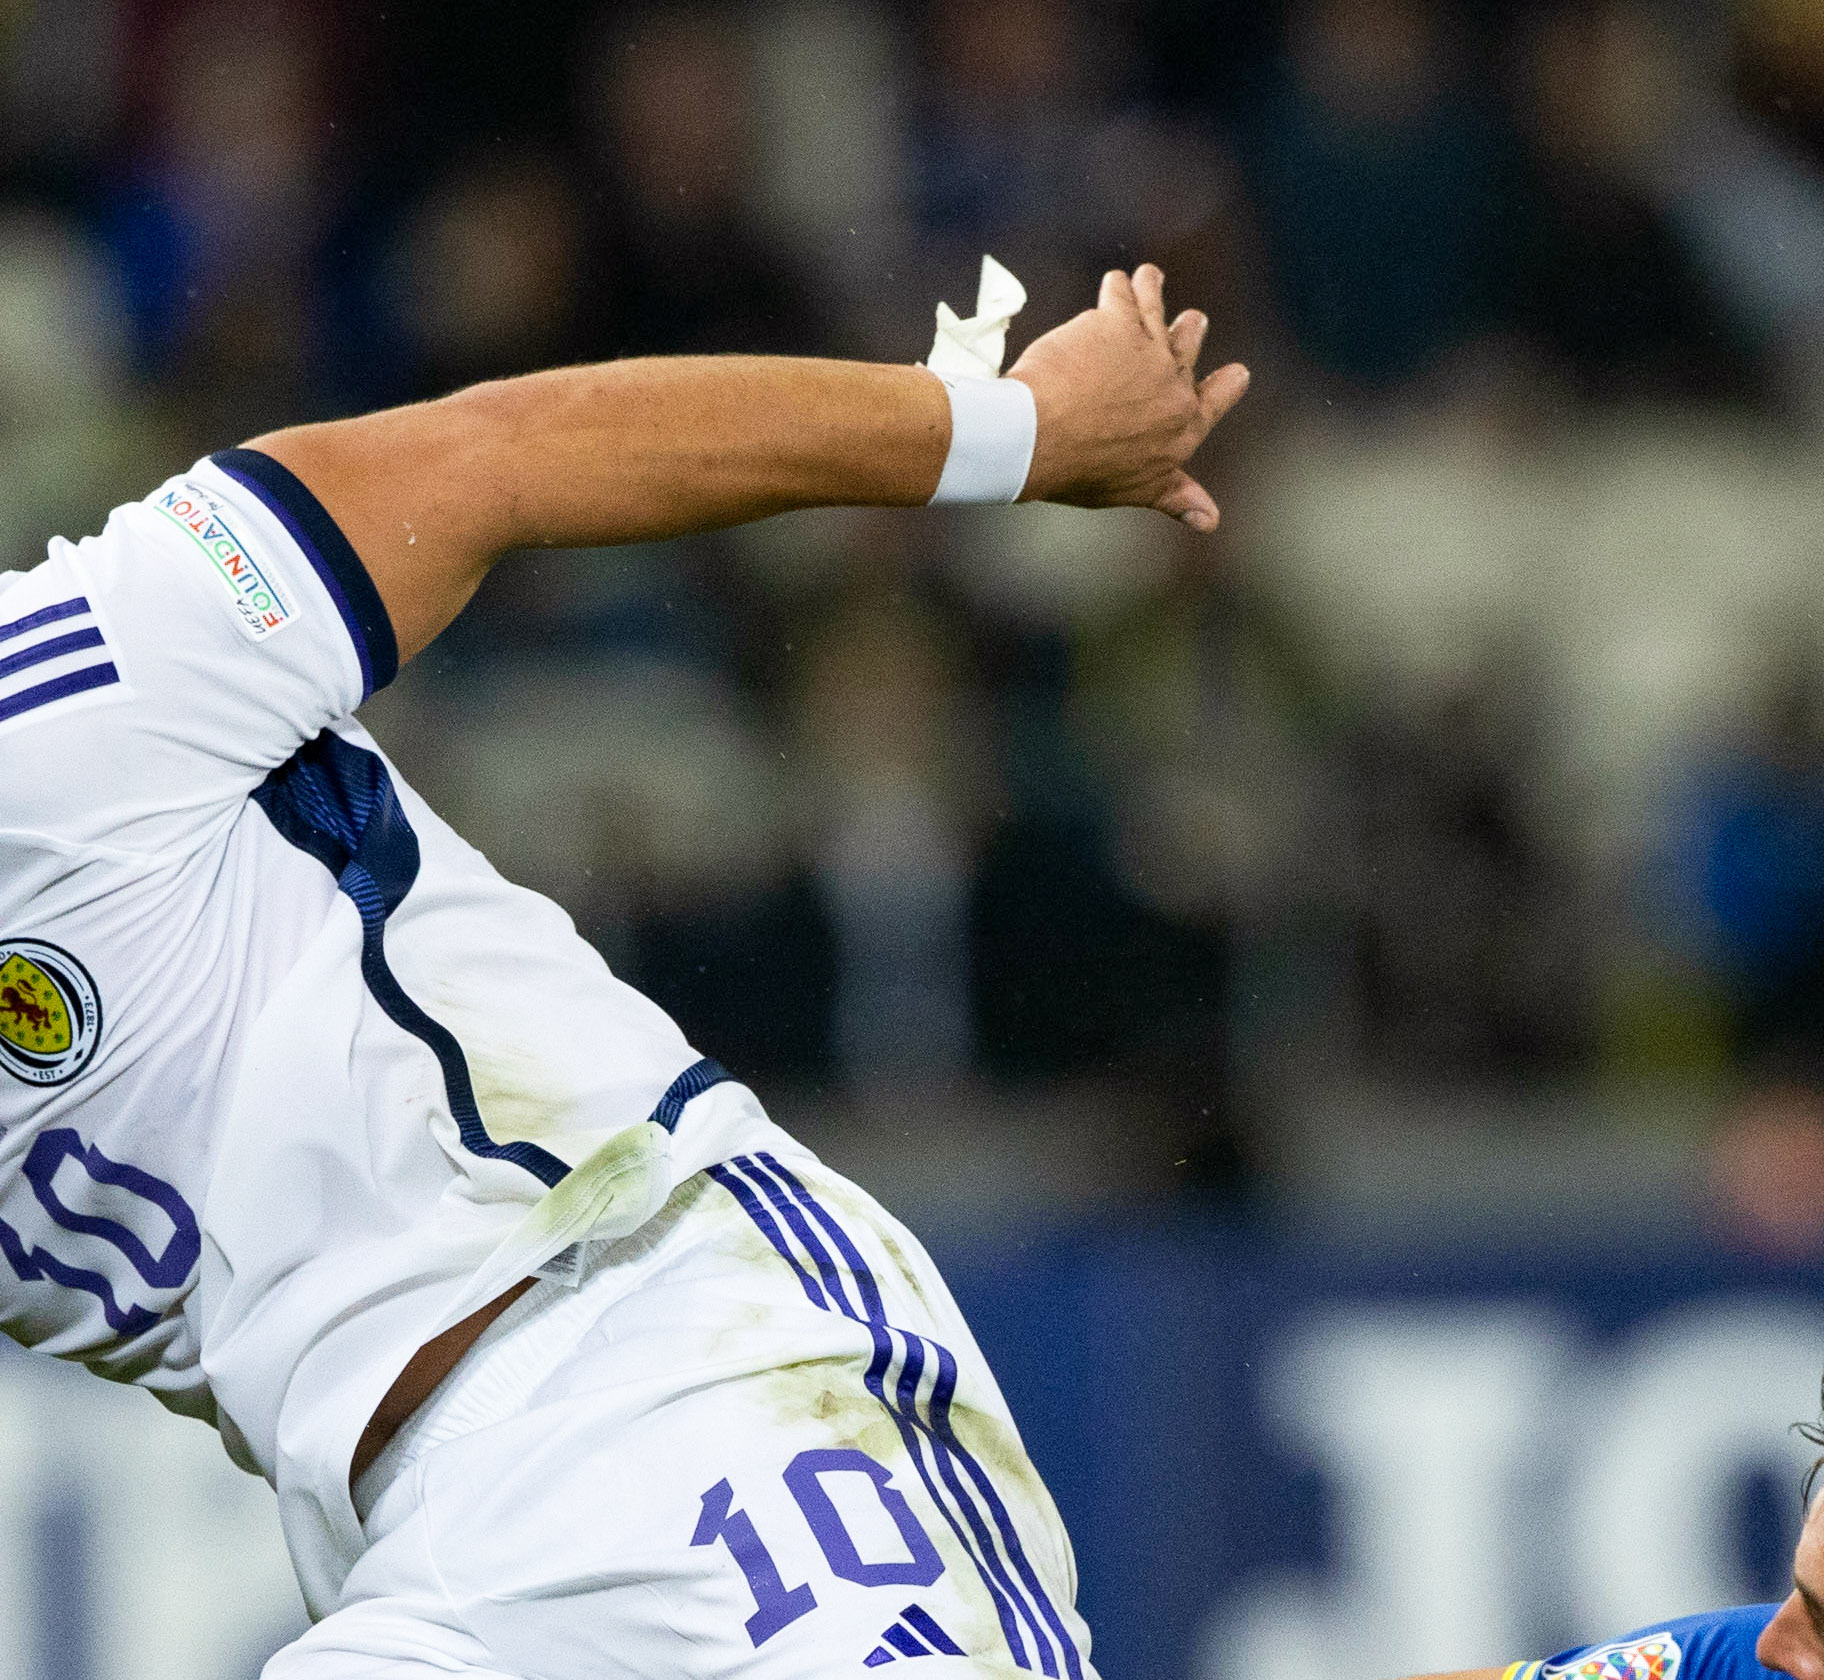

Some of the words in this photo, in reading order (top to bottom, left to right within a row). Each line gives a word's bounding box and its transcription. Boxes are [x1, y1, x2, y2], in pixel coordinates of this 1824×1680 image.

[160, 491, 284, 628] FOUNDATION
[236, 598, 266, 634] UEFA
[85, 1002, 95, 1026] 1873
[39, 1070, 56, 1080] EST
[690, 1449, 946, 1649] 10
